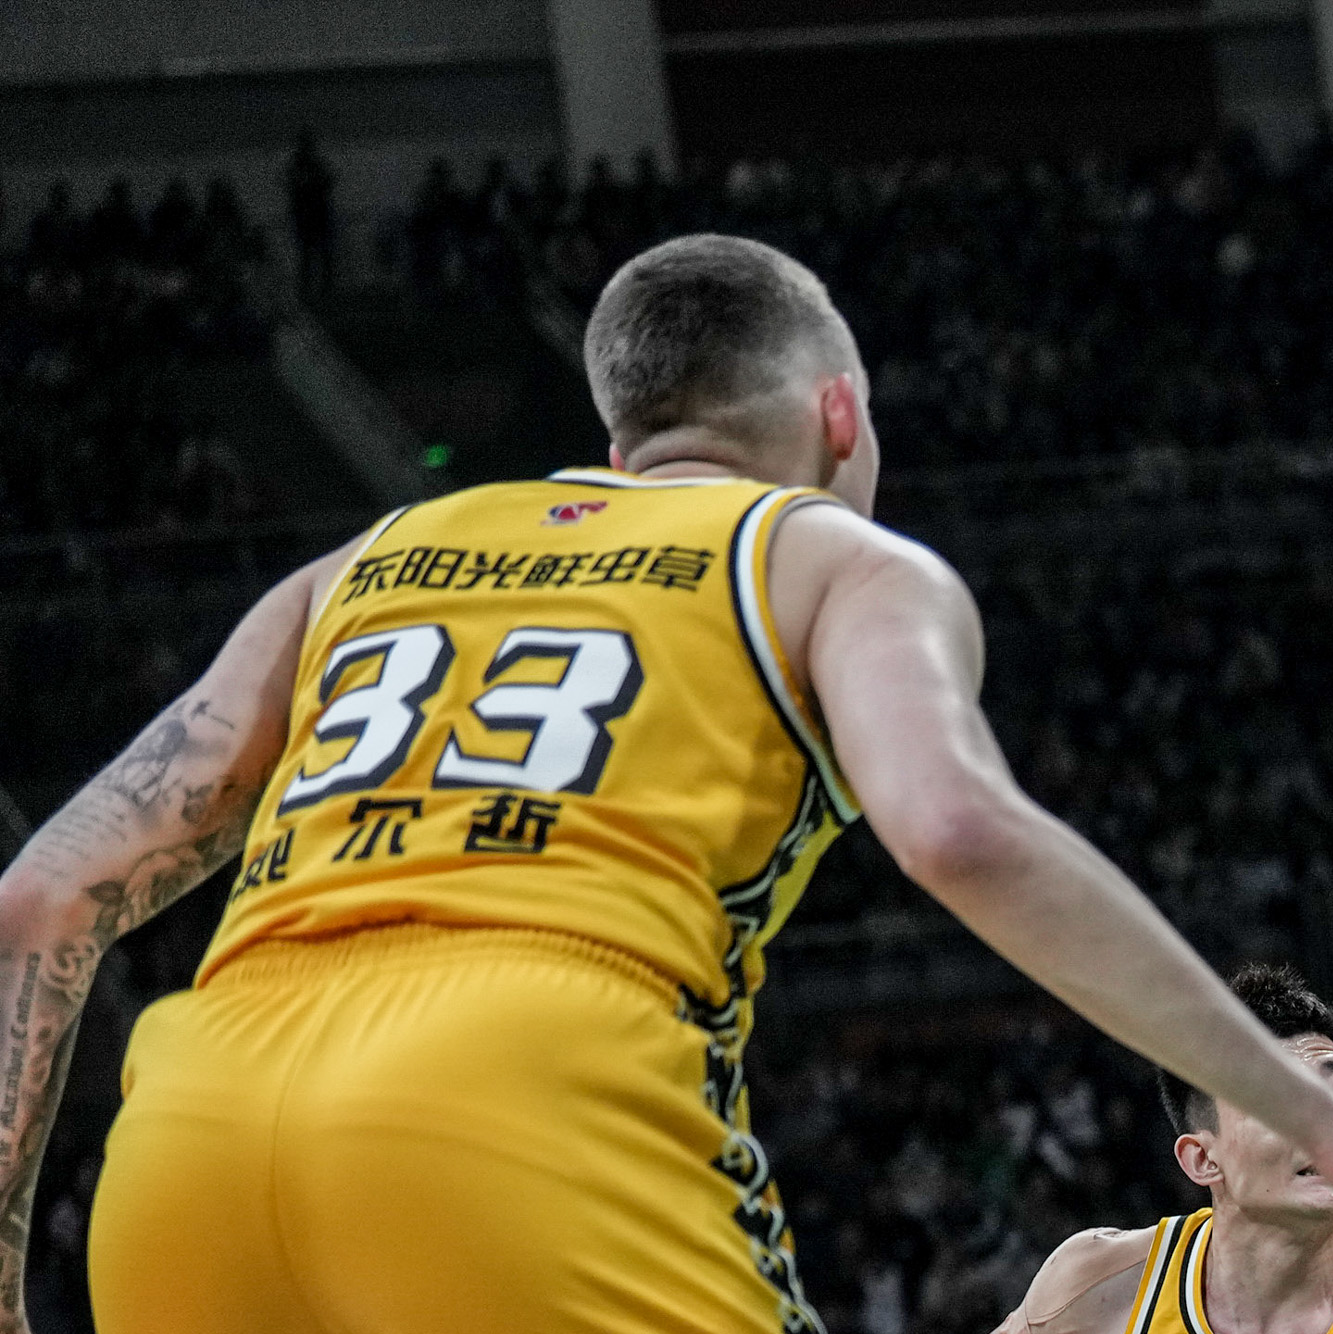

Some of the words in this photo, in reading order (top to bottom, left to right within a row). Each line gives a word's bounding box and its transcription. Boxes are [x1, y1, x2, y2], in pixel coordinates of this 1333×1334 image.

[341, 545, 716, 606] 东阳光鲜虫草
[277, 623, 644, 818] 33
